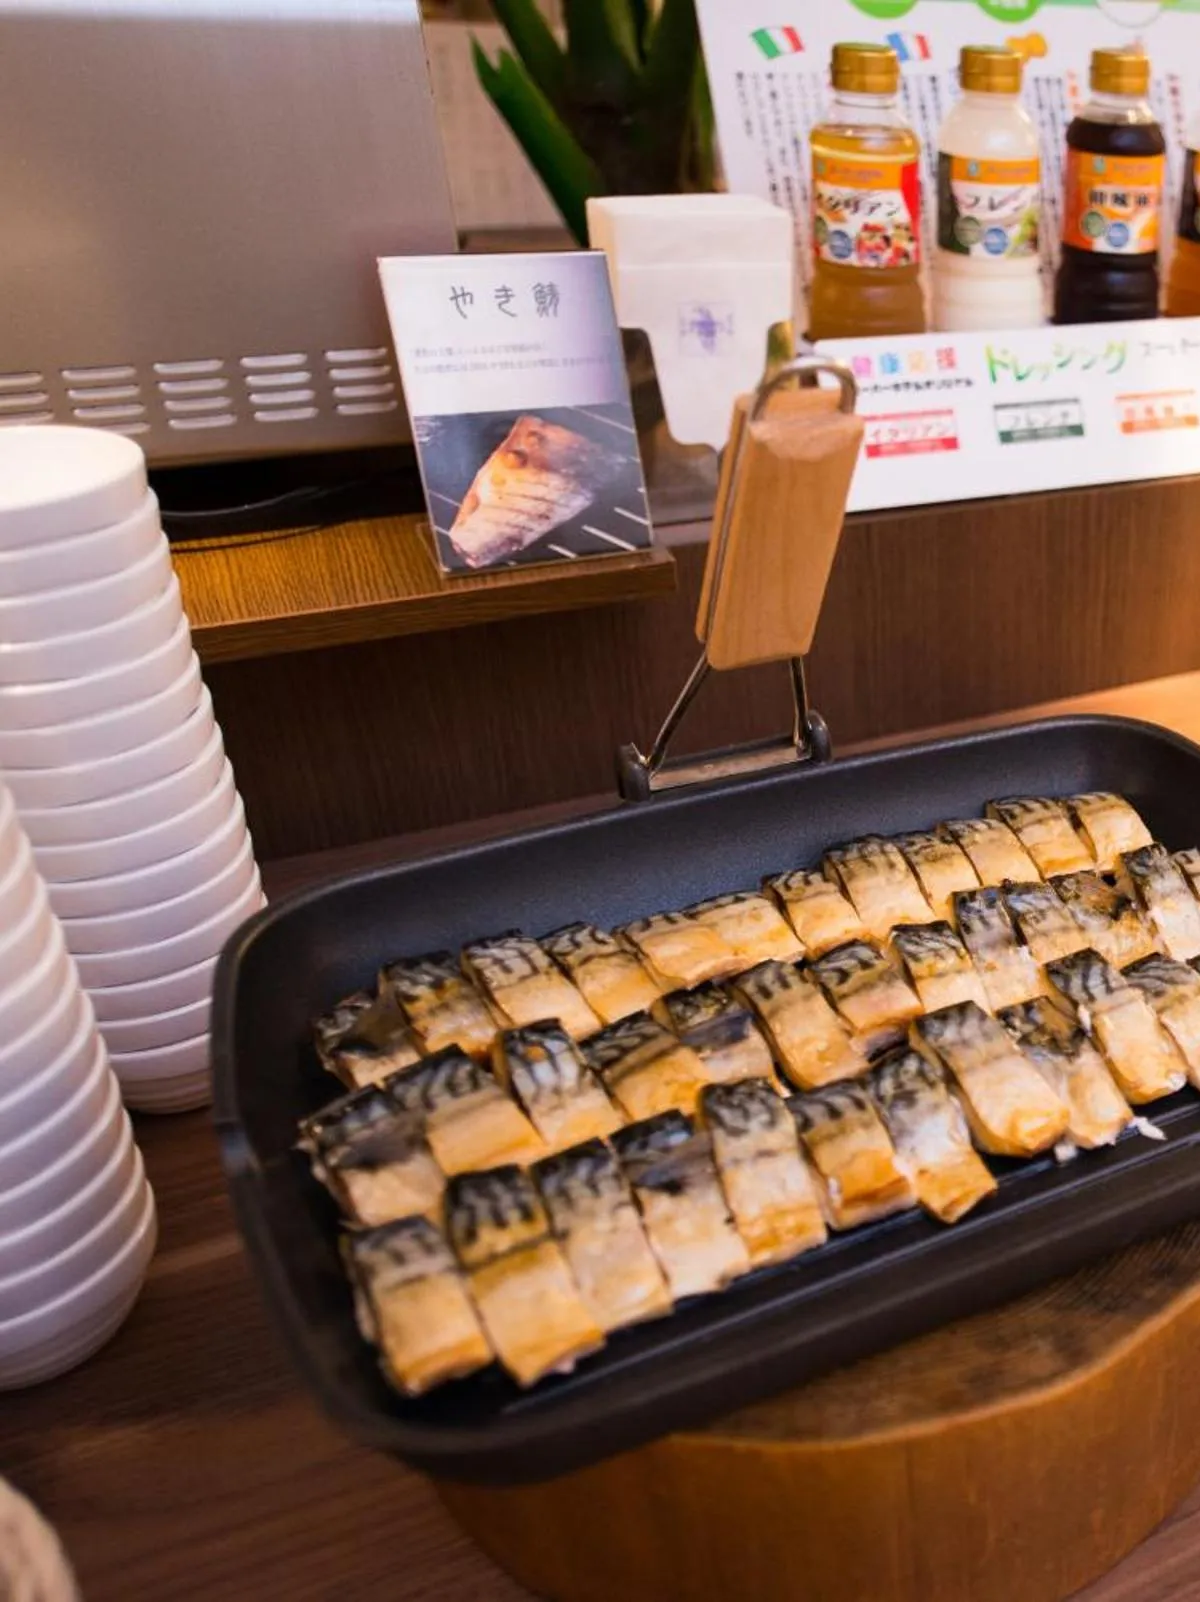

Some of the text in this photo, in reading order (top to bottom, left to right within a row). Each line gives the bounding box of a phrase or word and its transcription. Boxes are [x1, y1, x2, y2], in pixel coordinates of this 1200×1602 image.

[985, 339, 1128, 384] ドレッシング
